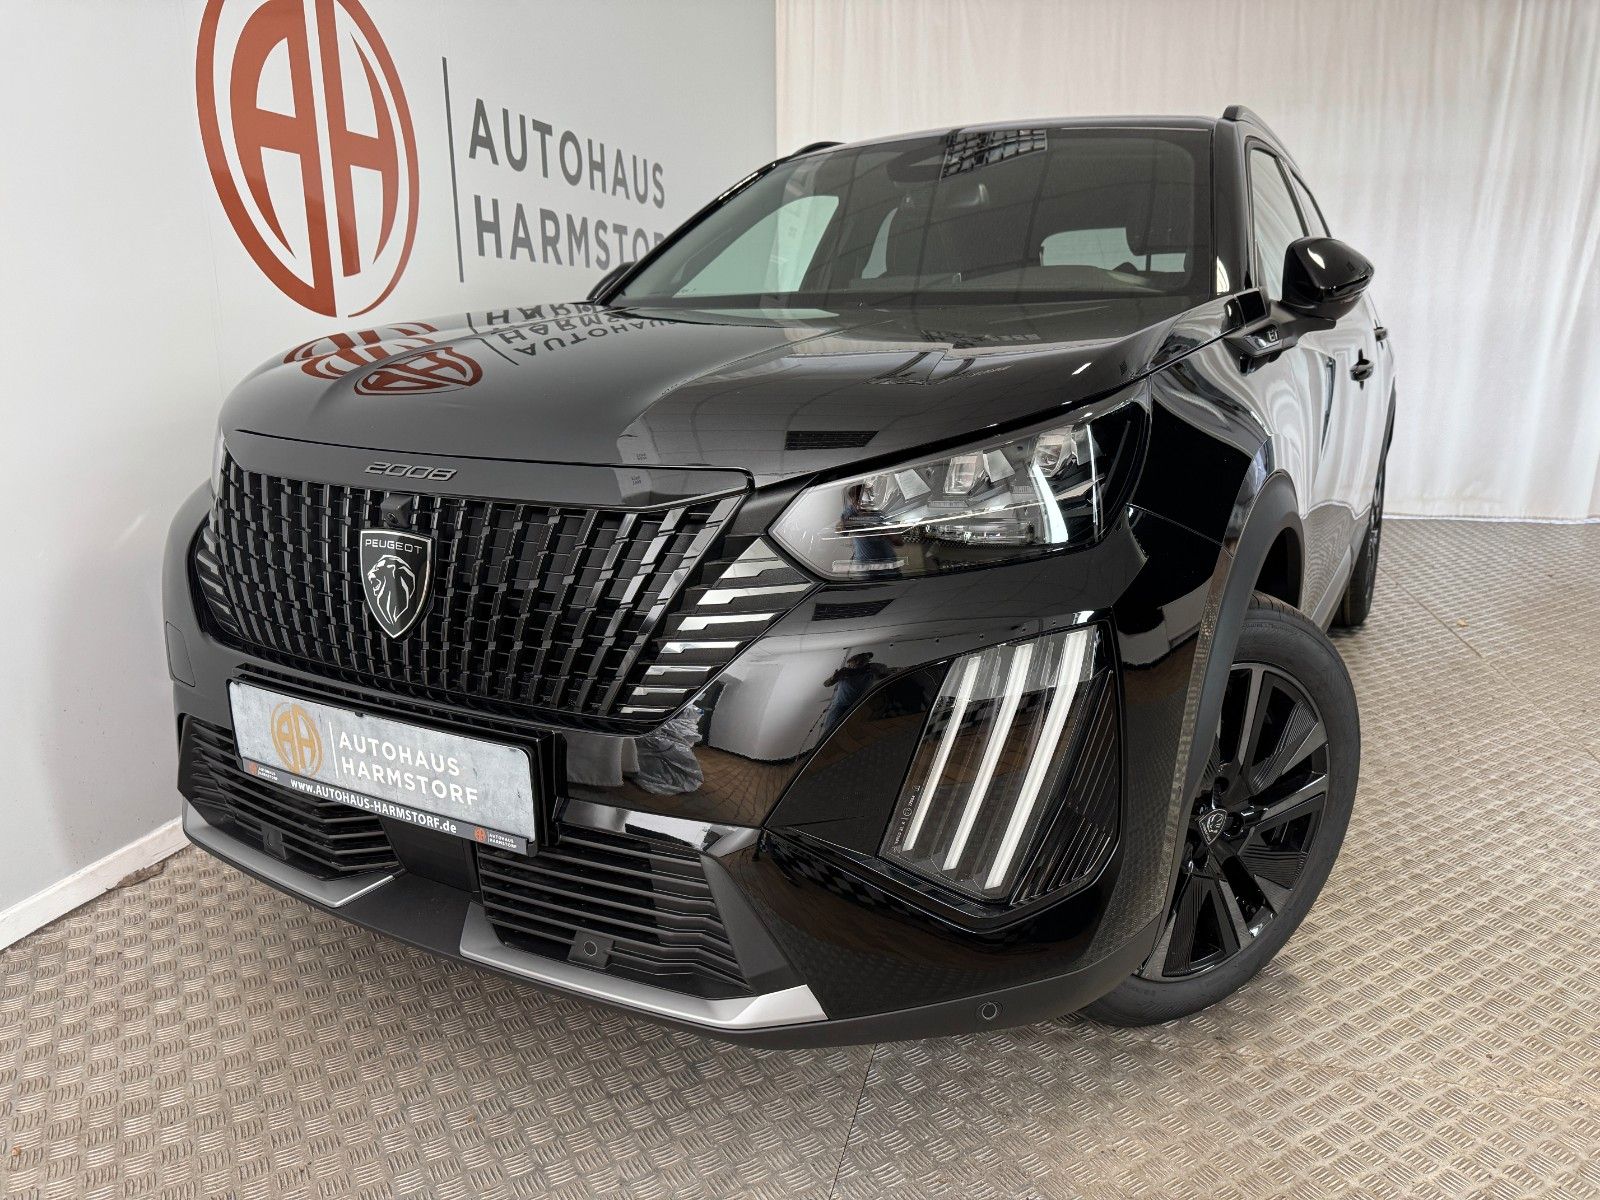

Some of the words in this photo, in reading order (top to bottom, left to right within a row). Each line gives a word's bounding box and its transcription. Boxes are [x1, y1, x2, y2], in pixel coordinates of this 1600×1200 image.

[469, 97, 666, 210] AUTOHAUS
[365, 461, 458, 482] 2008
[364, 538, 423, 555] PEUGEOT
[338, 730, 461, 777] AUTOHAUS
[290, 778, 458, 834] www.AUTOHAUS-HARMSTORF.de
[340, 756, 479, 807] HARMSTORF
